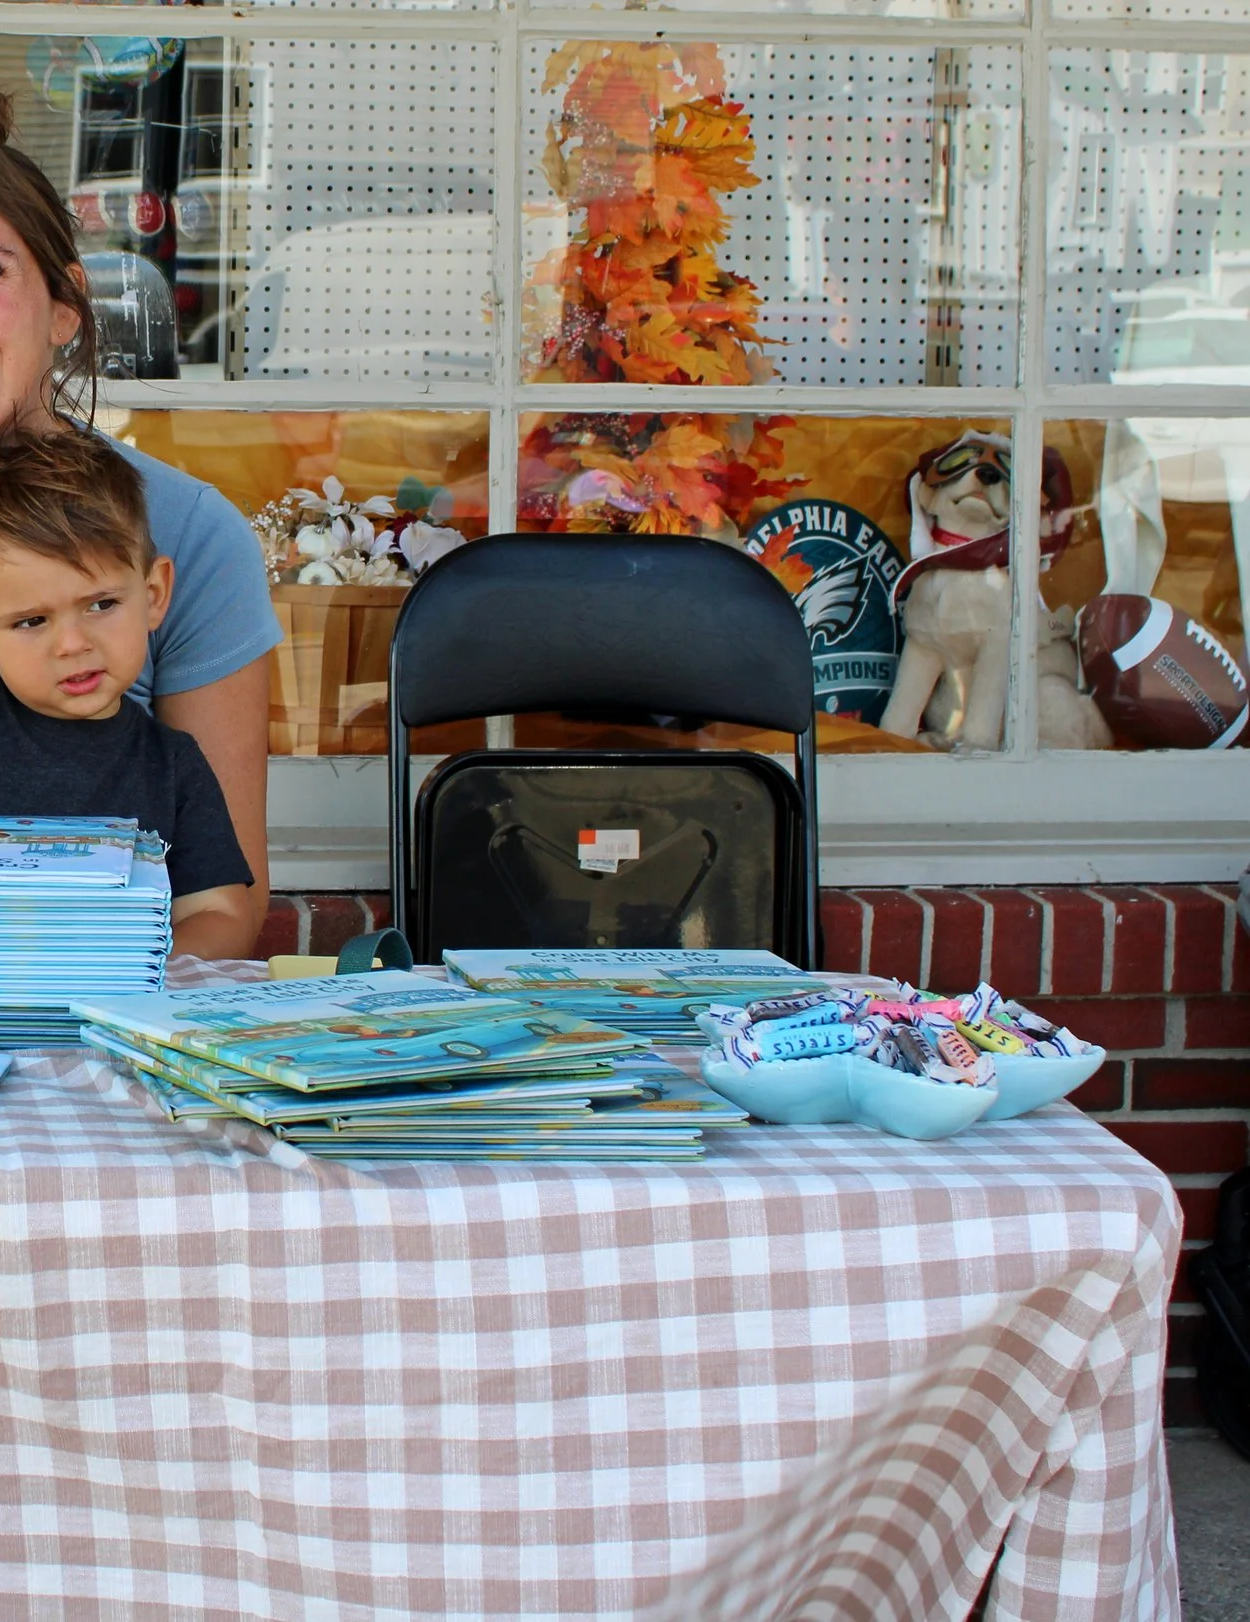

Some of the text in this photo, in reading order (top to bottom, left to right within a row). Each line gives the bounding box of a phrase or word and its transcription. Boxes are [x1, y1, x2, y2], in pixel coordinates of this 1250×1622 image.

[814, 660, 890, 684] MPIONS
[1160, 654, 1197, 692] SPORT
[530, 950, 721, 959] Cruise With Me
[615, 956, 668, 964] Isle
[673, 956, 721, 964] City
[168, 976, 365, 1001] Cruise With Me
[210, 994, 264, 1006] Sea
[266, 989, 313, 1000] Isle
[315, 984, 377, 995] City
[773, 1034, 847, 1056] STEEL'S
